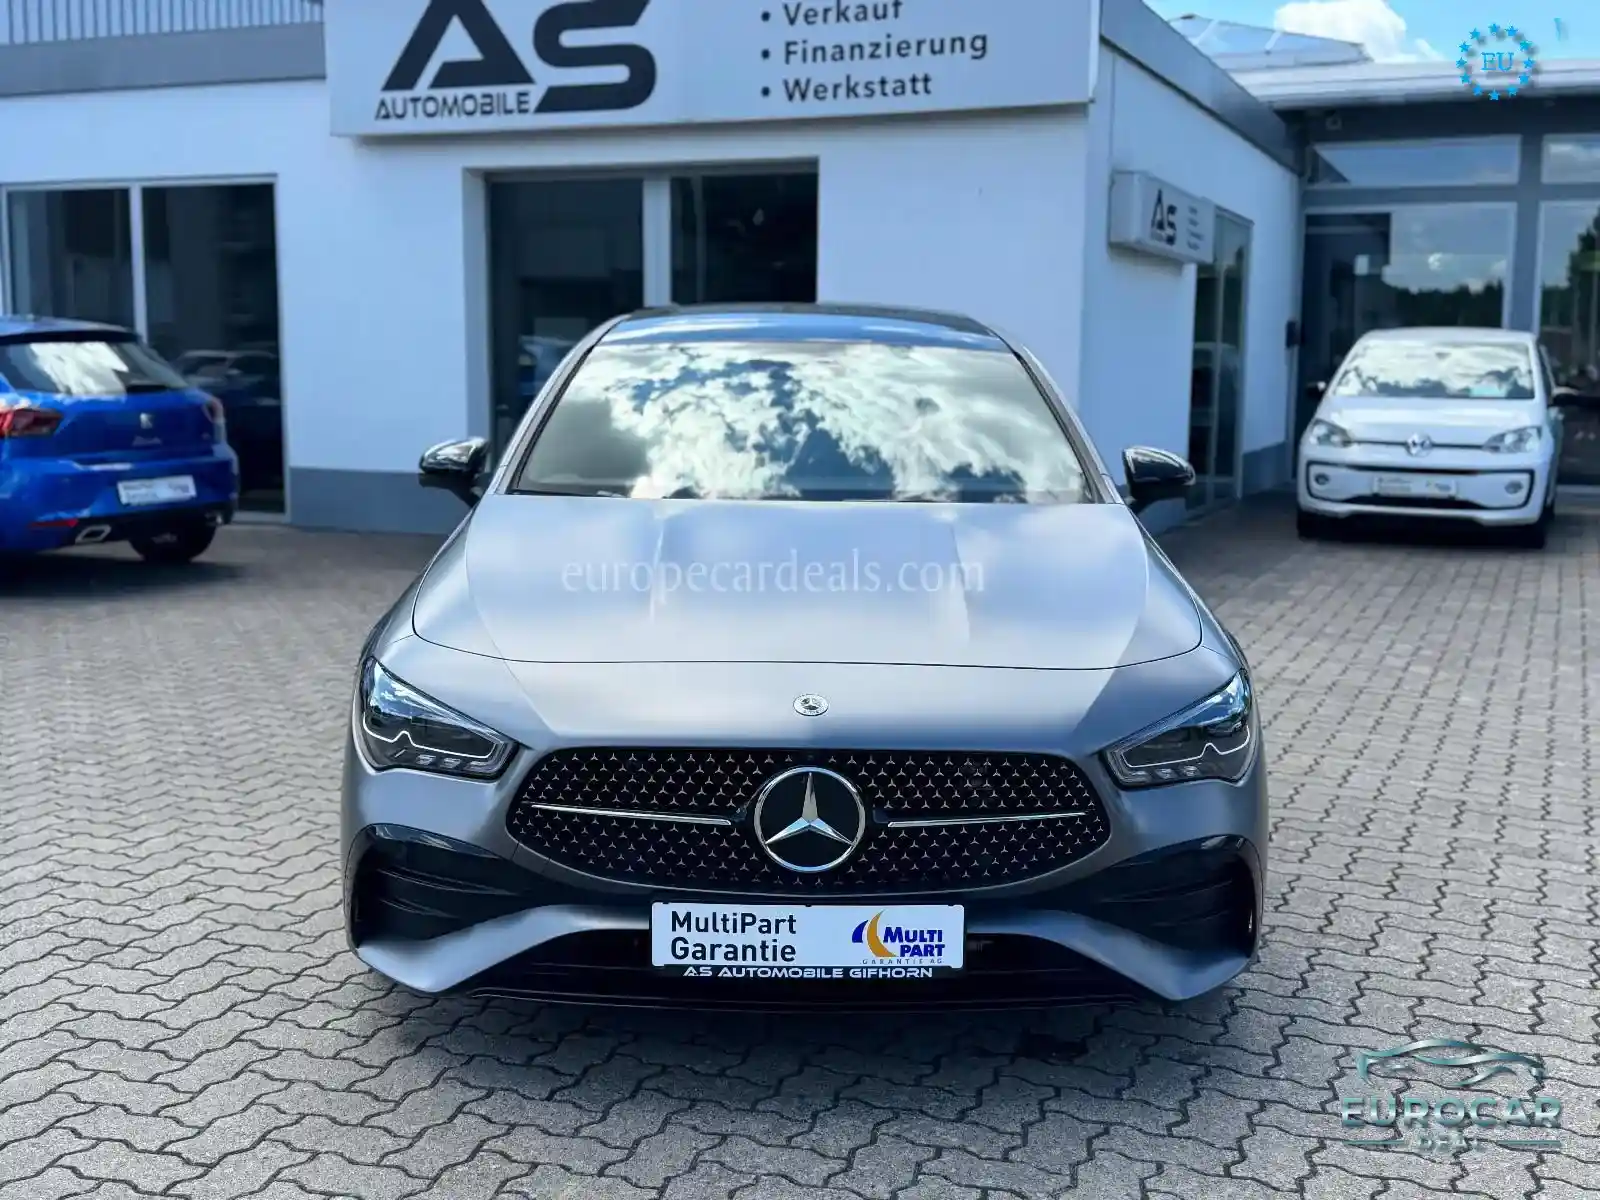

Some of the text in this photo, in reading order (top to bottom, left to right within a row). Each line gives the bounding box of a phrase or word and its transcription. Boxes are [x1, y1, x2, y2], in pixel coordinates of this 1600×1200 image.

[783, 0, 903, 26] Verkauf
[784, 34, 988, 64] Finanzierung
[783, 73, 932, 101] Werkstatt
[375, 91, 531, 120] AUTOMOBILE
[671, 911, 796, 934] MultiPart
[671, 937, 796, 962] Garantie
[900, 944, 945, 957] PART
[683, 967, 933, 978] AS AUTOMOBILE GIFHORN
